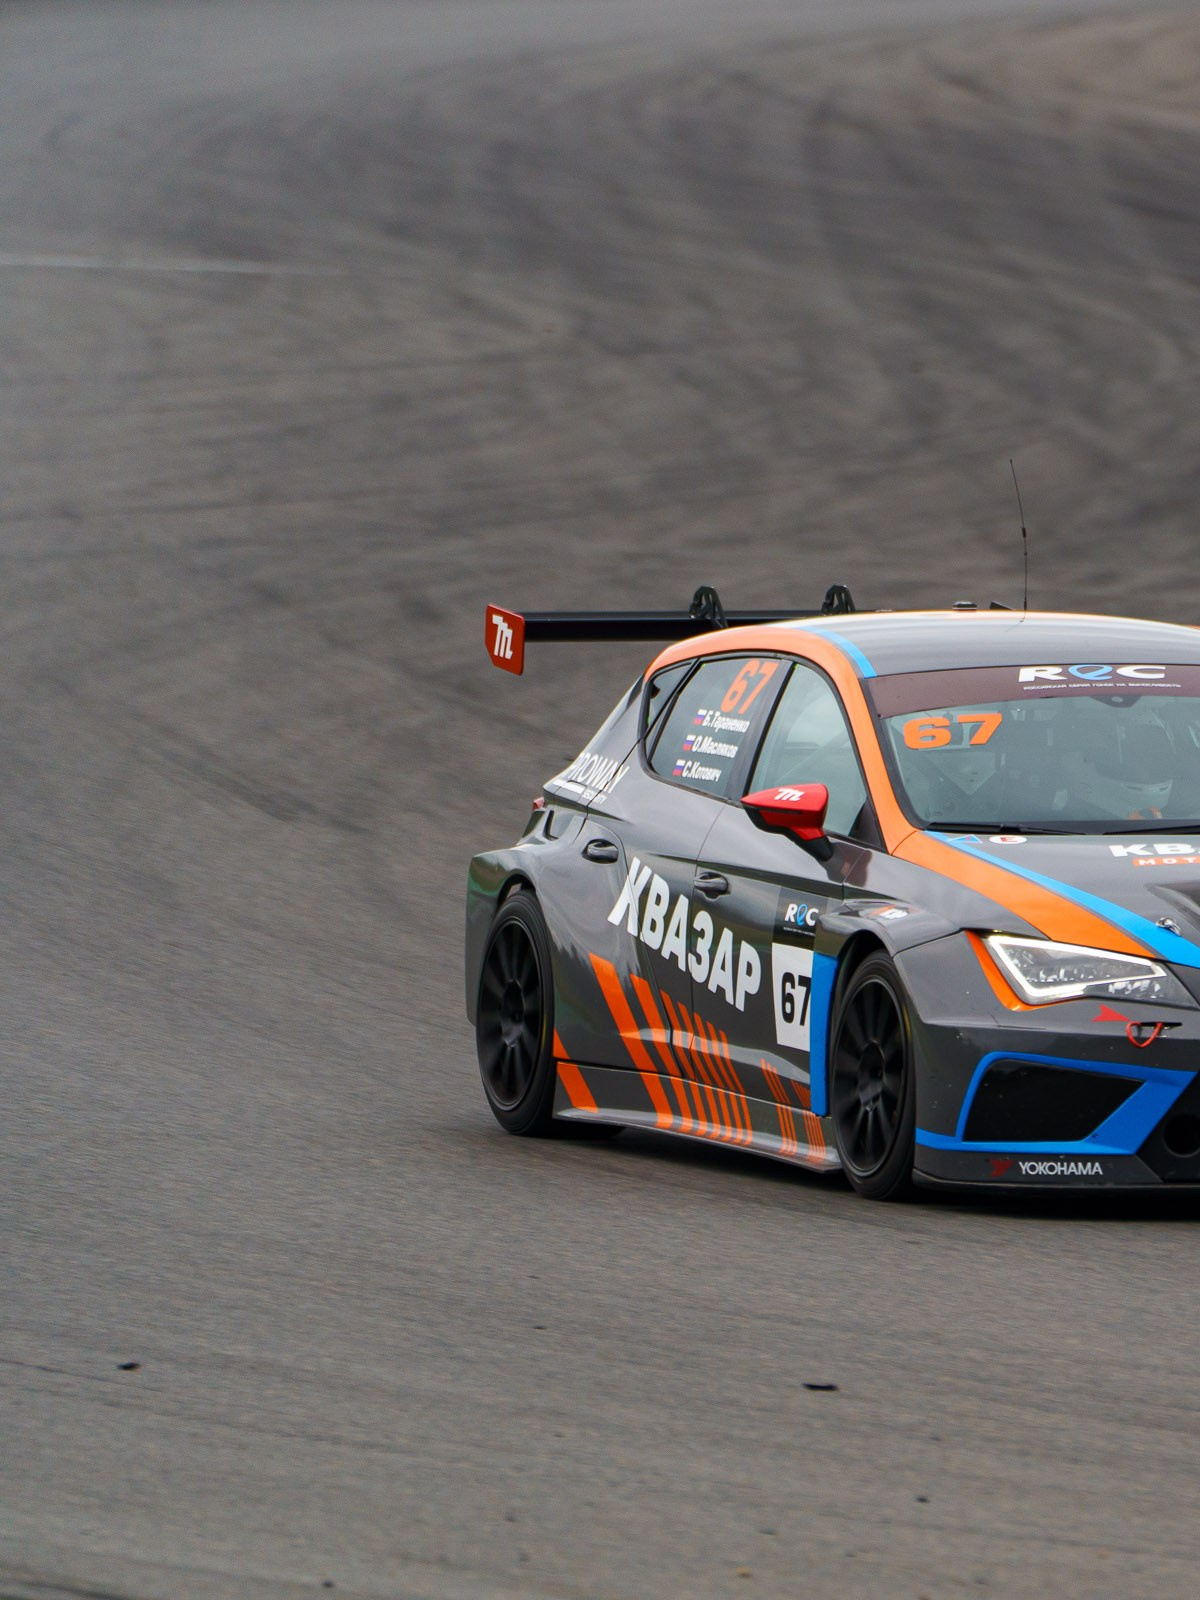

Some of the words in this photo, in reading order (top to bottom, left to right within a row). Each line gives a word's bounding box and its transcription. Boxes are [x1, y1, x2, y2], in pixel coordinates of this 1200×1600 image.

[720, 659, 779, 714] 67
[903, 712, 1002, 750] 67
[607, 857, 761, 1012] КВАЗАР
[781, 972, 811, 1026] 67
[1018, 1161, 1103, 1175] YOKOHAMA
